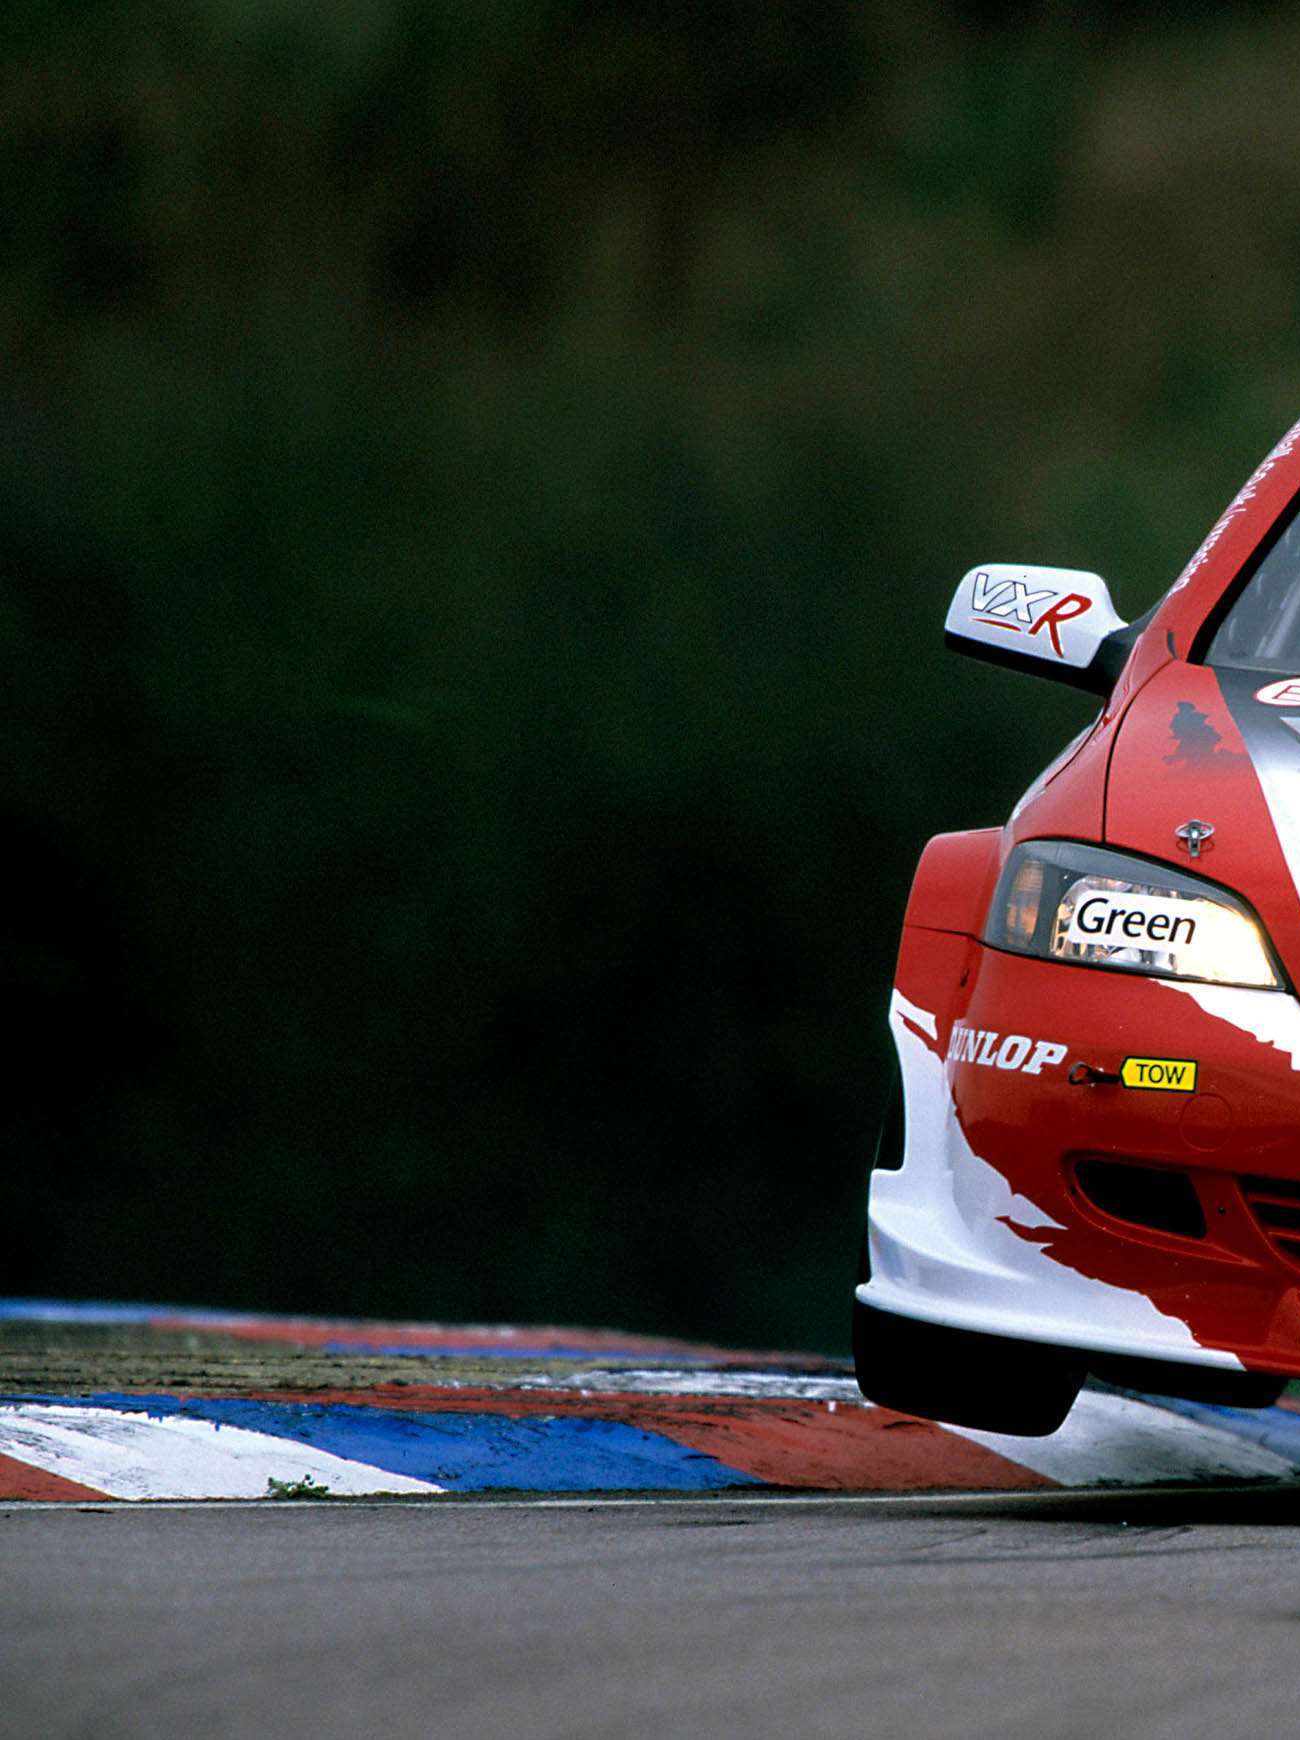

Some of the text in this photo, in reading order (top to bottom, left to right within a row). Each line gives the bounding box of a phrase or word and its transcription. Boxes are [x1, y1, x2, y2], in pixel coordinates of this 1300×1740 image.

[971, 572, 1092, 658] VXR
[1076, 897, 1197, 945] Green
[1136, 1063, 1187, 1085] TOW
